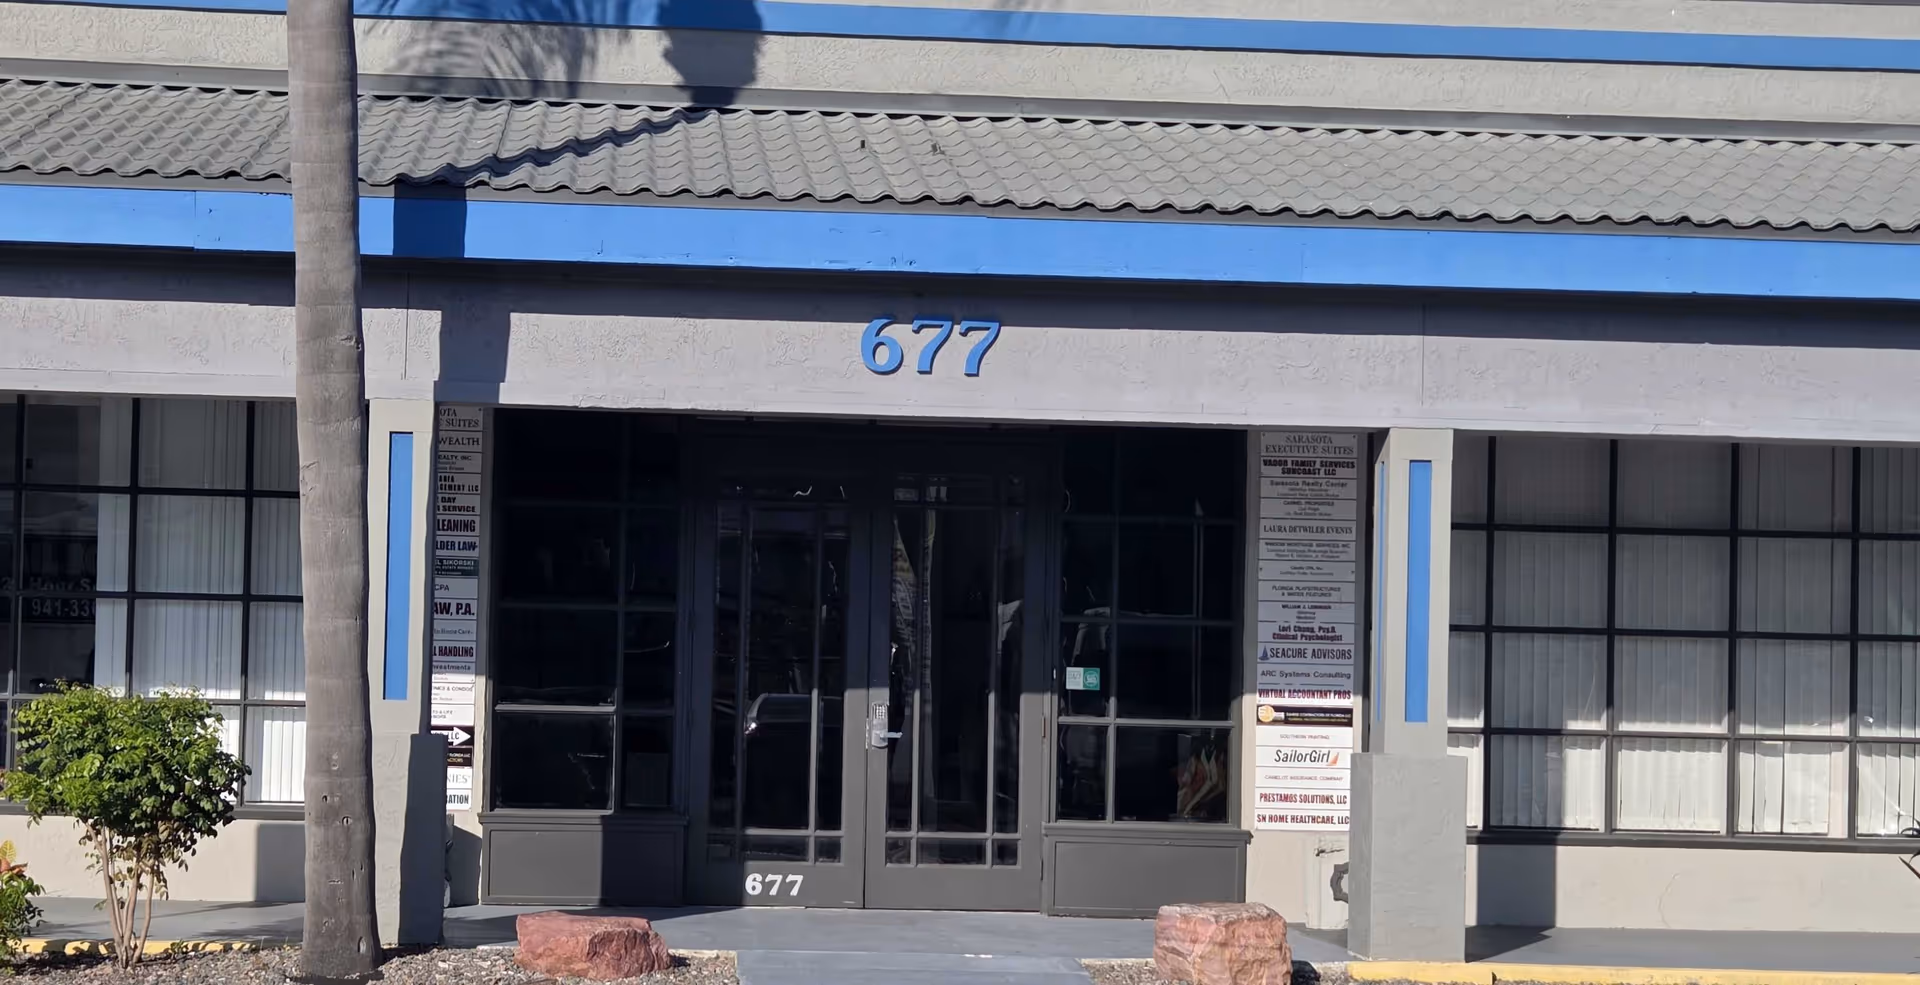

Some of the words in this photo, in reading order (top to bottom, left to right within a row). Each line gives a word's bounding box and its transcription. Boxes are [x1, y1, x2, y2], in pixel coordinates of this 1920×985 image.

[861, 318, 1000, 377] 677
[440, 408, 457, 417] OTA
[446, 419, 480, 428] SUITES
[1285, 435, 1333, 444] SARASOTA
[1265, 445, 1319, 454] EXECUTIVE
[1321, 446, 1354, 455] SUITES
[1291, 460, 1317, 468] FAMILY
[1320, 461, 1355, 469] SERVICES
[1281, 467, 1321, 476] SUNCOAST
[1324, 468, 1337, 476] LLC
[440, 483, 465, 492] GEMENT
[468, 484, 479, 492] LLC
[442, 505, 476, 513] SERVICE
[437, 519, 476, 532] LEANING
[1263, 525, 1288, 534] LAURA
[1288, 525, 1326, 534] DETWILER
[1327, 526, 1353, 535] EVENTS
[436, 541, 456, 551] LDER
[80, 578, 96, 591] S
[32, 598, 96, 617] 941-33
[434, 602, 453, 616] AW,
[1301, 634, 1342, 642] Psychologist
[439, 646, 473, 657] HANDLING
[1270, 647, 1308, 659] SEACURE
[1311, 648, 1352, 660] ADVISORS
[1280, 670, 1310, 679] Systems
[1313, 671, 1351, 680] Consulting
[1258, 688, 1286, 698] VIRTUAL
[1288, 689, 1332, 699] ACCOUNTANT
[1333, 690, 1352, 700] PROS
[1274, 749, 1331, 763] SailorGirl
[447, 794, 469, 805] ATION
[1260, 792, 1298, 803] PRESTAMOS
[1299, 794, 1335, 805] SOLUTIONS,
[1337, 795, 1347, 805] LLC
[1257, 814, 1266, 823] SN
[1268, 814, 1289, 824] HOME
[1291, 815, 1336, 825] HEALTHCARE,
[1337, 816, 1350, 825] LLC
[745, 873, 804, 896] 677
